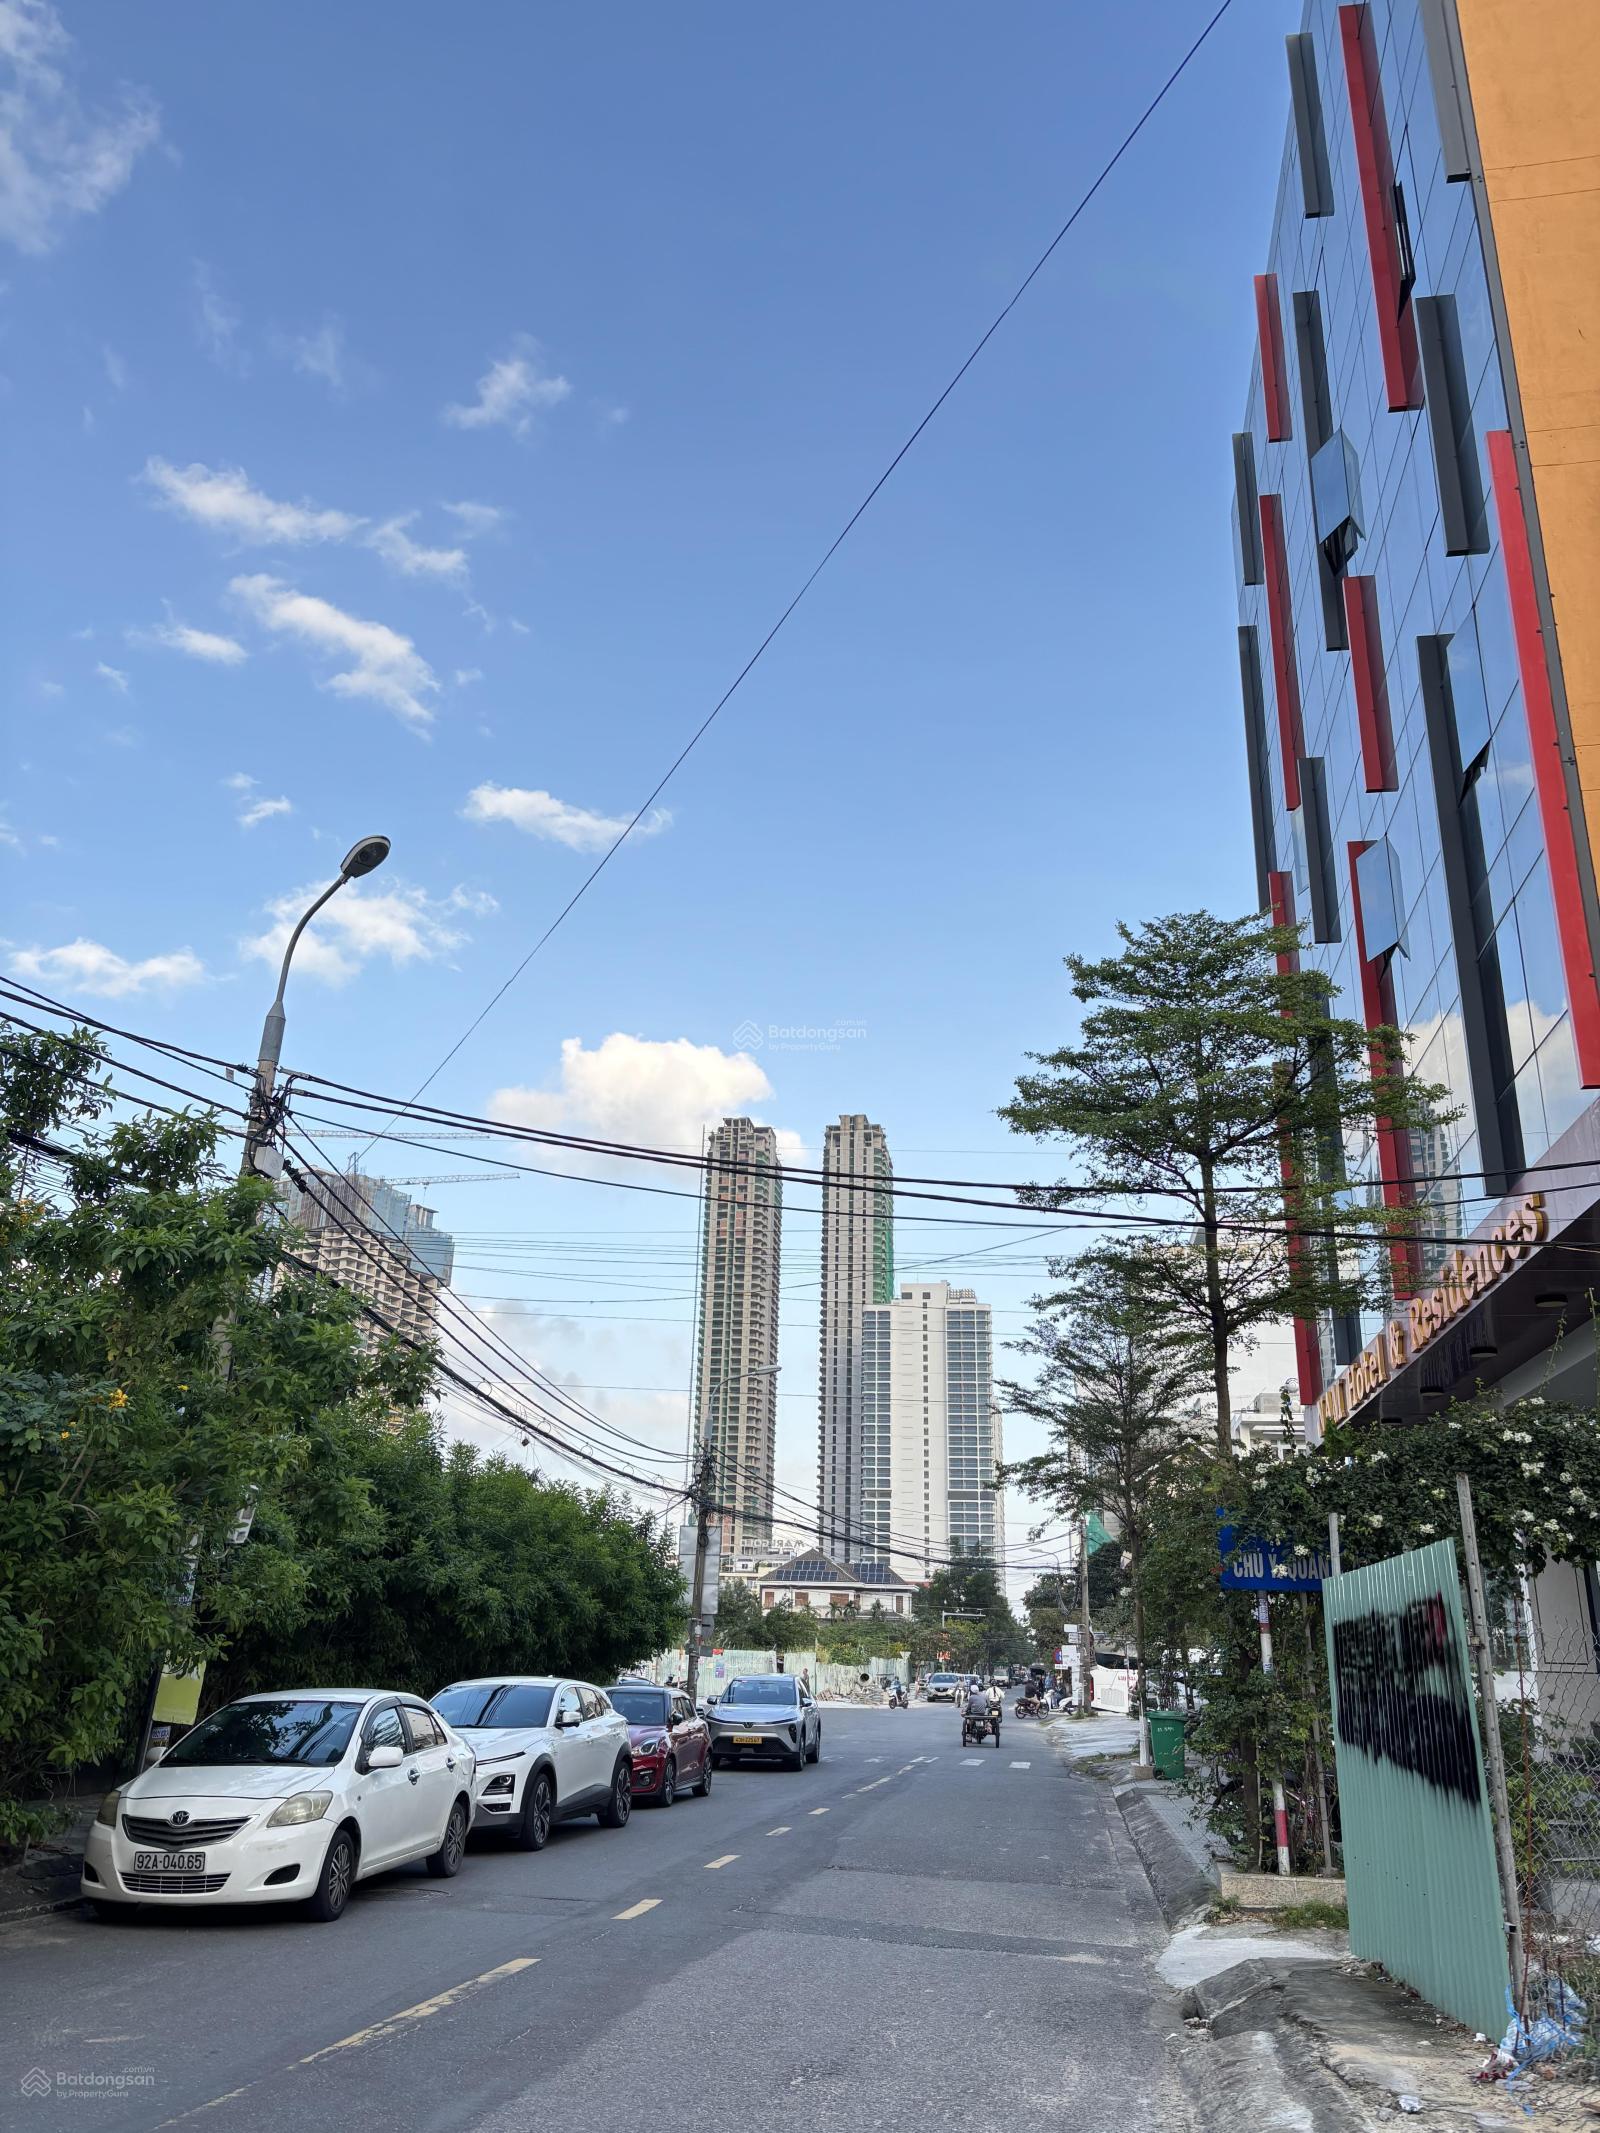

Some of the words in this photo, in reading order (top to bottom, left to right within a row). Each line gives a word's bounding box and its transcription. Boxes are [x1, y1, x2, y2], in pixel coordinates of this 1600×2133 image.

[1345, 1333, 1388, 1411] Hotel
[1389, 1320, 1408, 1369] &
[1409, 1193, 1545, 1353] Residences
[1233, 1547, 1264, 1578] CHÚ
[136, 1854, 203, 1869] 92A-040.65
